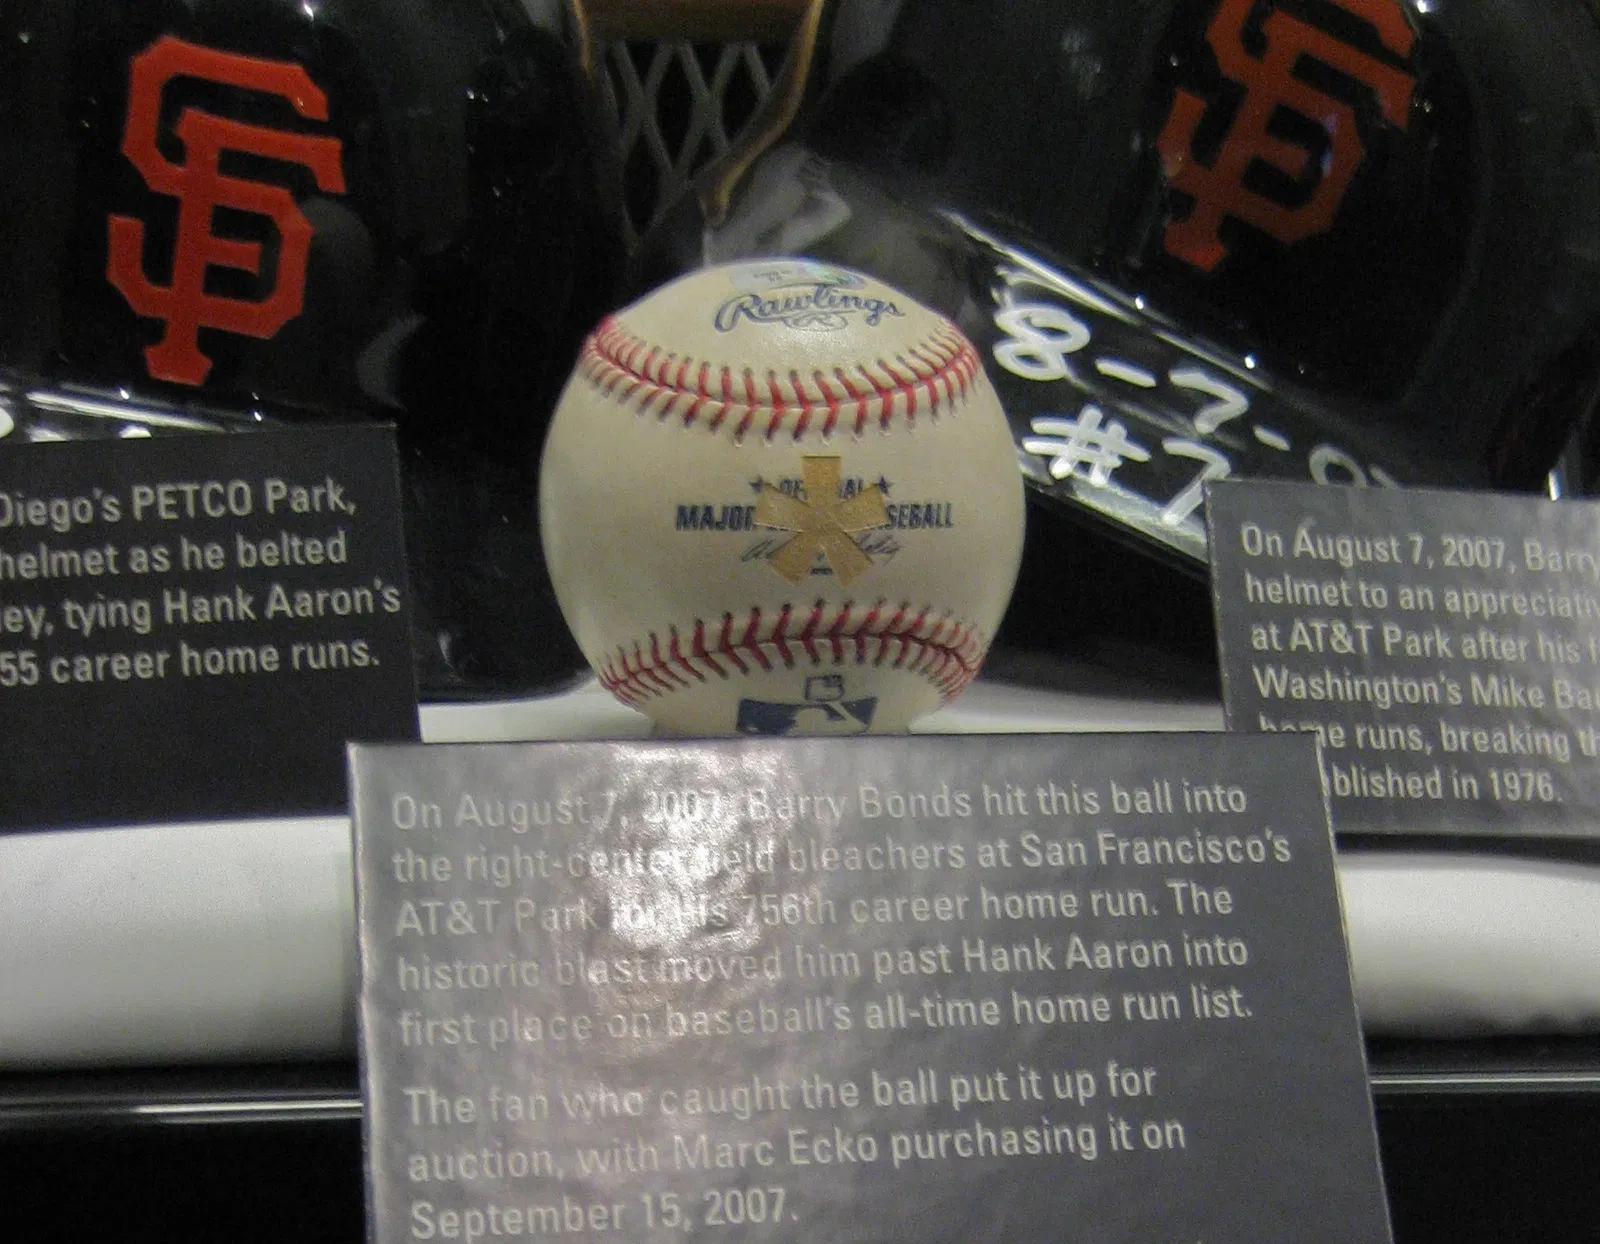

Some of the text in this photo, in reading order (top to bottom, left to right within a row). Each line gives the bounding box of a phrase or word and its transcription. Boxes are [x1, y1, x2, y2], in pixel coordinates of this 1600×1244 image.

[714, 284, 906, 333] Rawlings
[132, 479, 253, 521] PETCO
[264, 476, 357, 516] Park,
[129, 545, 171, 574] as
[180, 537, 226, 571] he
[236, 531, 348, 569] belted
[1241, 523, 1284, 558] On
[1293, 525, 1402, 568] August
[1407, 534, 1435, 569] 7,
[1442, 534, 1517, 575] 2007,
[0, 577, 401, 641] ey, tying Hank Aaron's
[1245, 569, 1353, 606] helmet
[1359, 577, 1388, 610] to
[1400, 586, 1435, 612] an
[51, 650, 171, 684] career
[180, 642, 281, 677] home
[292, 639, 381, 671] runs.
[1251, 623, 1284, 652] at
[1290, 621, 1374, 655] AT&T
[1383, 622, 1452, 659] Park
[1462, 630, 1529, 663] after
[1537, 629, 1581, 665] his
[1252, 664, 1463, 710] Washington's
[1470, 673, 1545, 709] Mike
[1355, 722, 1433, 756] runs,
[1440, 718, 1570, 763] breaking
[392, 794, 442, 830] On
[456, 793, 588, 834] August
[746, 788, 847, 826] Barry
[859, 783, 972, 819] Bonds
[982, 780, 1028, 816] hit
[1037, 780, 1100, 816] this
[1110, 778, 1173, 815] ball
[1181, 777, 1248, 814] into
[1452, 767, 1479, 800] in
[1490, 767, 1563, 803] 1976.
[393, 849, 453, 883] the
[787, 836, 966, 874] bleachers
[977, 836, 1012, 868] at
[1020, 831, 1088, 868] San
[1098, 827, 1292, 867] Francisco's
[395, 901, 501, 937] AT&T
[514, 897, 599, 933] Park
[742, 885, 837, 927] 756th
[849, 893, 970, 923] career
[981, 884, 1079, 921] home
[1090, 889, 1159, 918] run.
[1165, 879, 1233, 916] The
[399, 930, 1250, 992] historic blast moved him past Hank Aaron into
[400, 984, 1254, 1051] first place on baseball's all-time home run list.
[403, 1059, 1157, 1126] The fan who caught the ball put it up for
[408, 1112, 1187, 1182] auction, with Marc Ecko purchasing it on
[410, 1187, 800, 1244] September 15, 2007.
